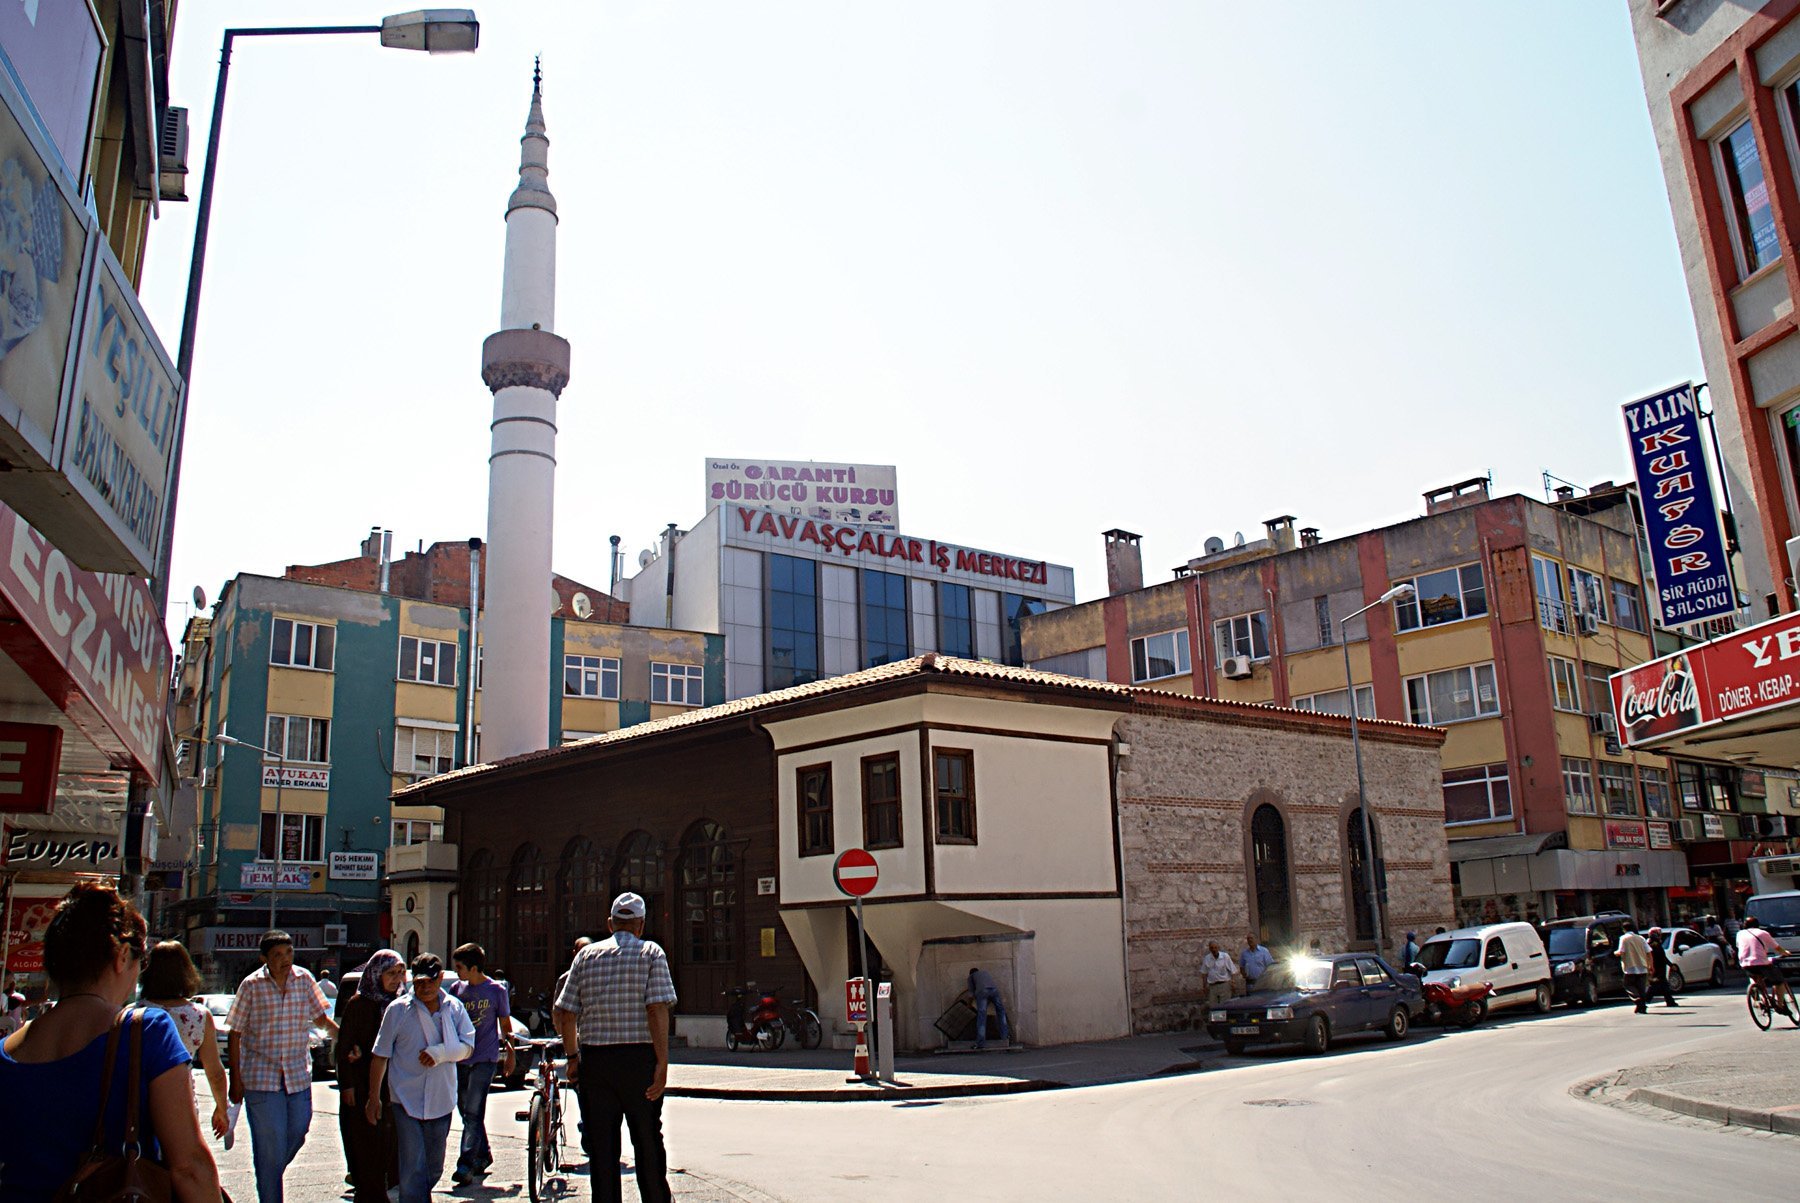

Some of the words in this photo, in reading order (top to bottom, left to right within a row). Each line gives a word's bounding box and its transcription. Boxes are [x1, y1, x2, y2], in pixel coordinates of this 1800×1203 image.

[92, 283, 174, 455] YEŞİLLİ
[1625, 389, 1693, 432] YALIN
[744, 465, 856, 484] GARANTİ
[711, 479, 807, 502] SÜRÜCÜ
[816, 486, 895, 506] KURSU
[738, 506, 924, 562] YAVAŞÇALAR
[930, 540, 951, 573] İŞ
[956, 549, 1048, 585] MERKEZİ
[1665, 592, 1728, 618] SALONU
[9, 512, 161, 765] ECZANESİ
[1620, 670, 1697, 727] Coca-Cola
[1718, 686, 1753, 712] DÖNER
[1758, 674, 1792, 702] KEBAP
[265, 768, 328, 780] AVUKAT
[293, 780, 328, 788] ERKANLI
[253, 873, 302, 883] EMLAK
[214, 933, 262, 947] MERVE
[849, 1001, 867, 1012] WC
